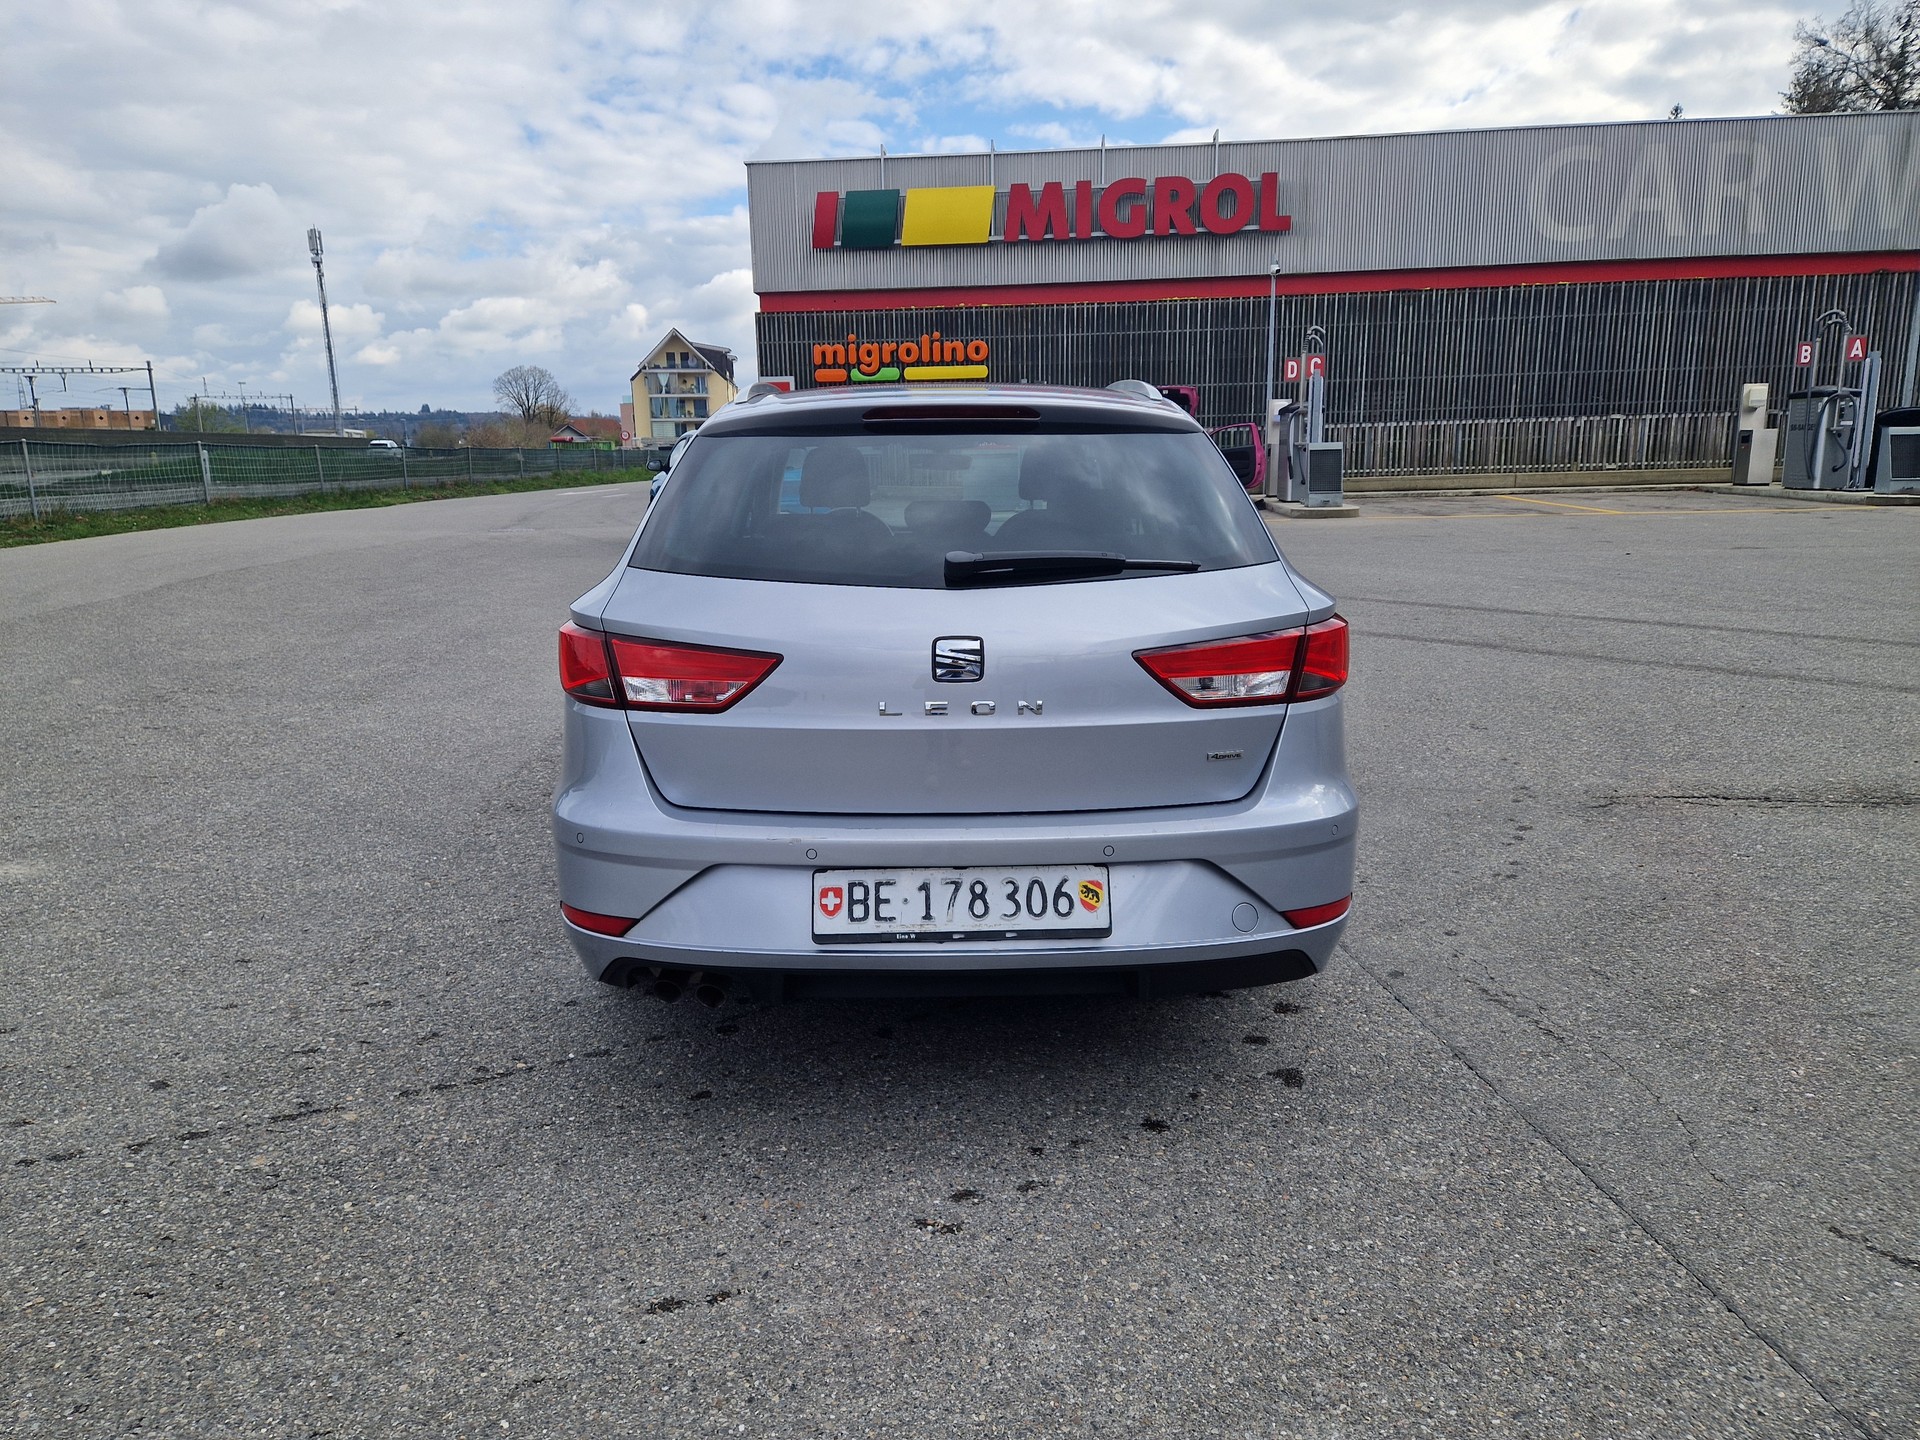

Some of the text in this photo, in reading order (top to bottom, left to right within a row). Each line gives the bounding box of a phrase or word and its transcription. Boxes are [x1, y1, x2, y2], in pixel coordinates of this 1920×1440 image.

[1530, 138, 1771, 243] CAR
[1003, 172, 1291, 242] MIGROL
[813, 331, 989, 374] migrolino
[1800, 345, 1812, 363] B
[1849, 338, 1863, 358] A
[1287, 360, 1298, 379] D
[878, 700, 1043, 716] LEON
[1210, 752, 1242, 760] 4DRIVE
